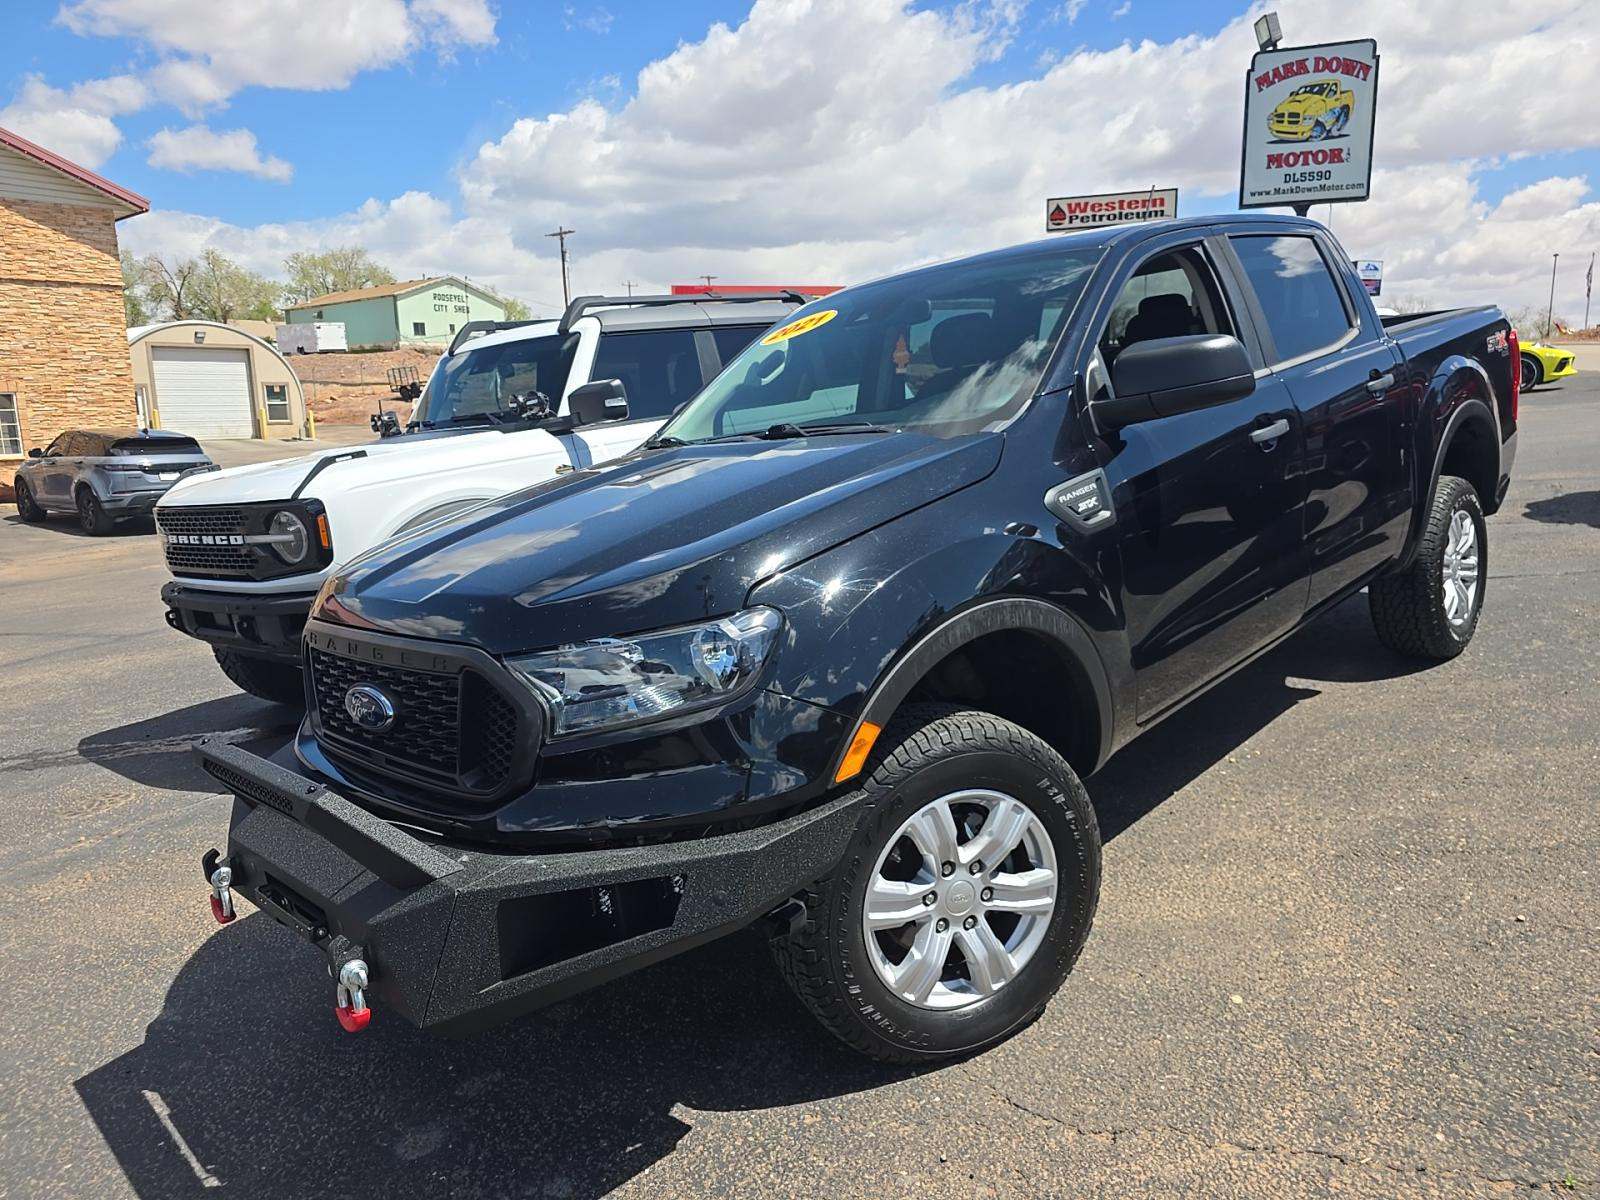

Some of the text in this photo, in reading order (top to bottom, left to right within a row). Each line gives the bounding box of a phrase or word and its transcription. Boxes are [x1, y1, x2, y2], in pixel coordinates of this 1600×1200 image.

[1255, 56, 1373, 92] MARK DOWN
[1266, 147, 1345, 170] MOTOR
[1284, 170, 1332, 184] DL5590
[1249, 182, 1365, 198] www.MarkDownMotor.com
[1066, 197, 1165, 214] Western
[1067, 209, 1165, 224] Petroleum
[433, 304, 448, 313] CITY
[766, 312, 830, 342] 2021
[1058, 482, 1097, 503] RANGER
[168, 535, 244, 545] BRONCO
[309, 632, 448, 670] RANGER
